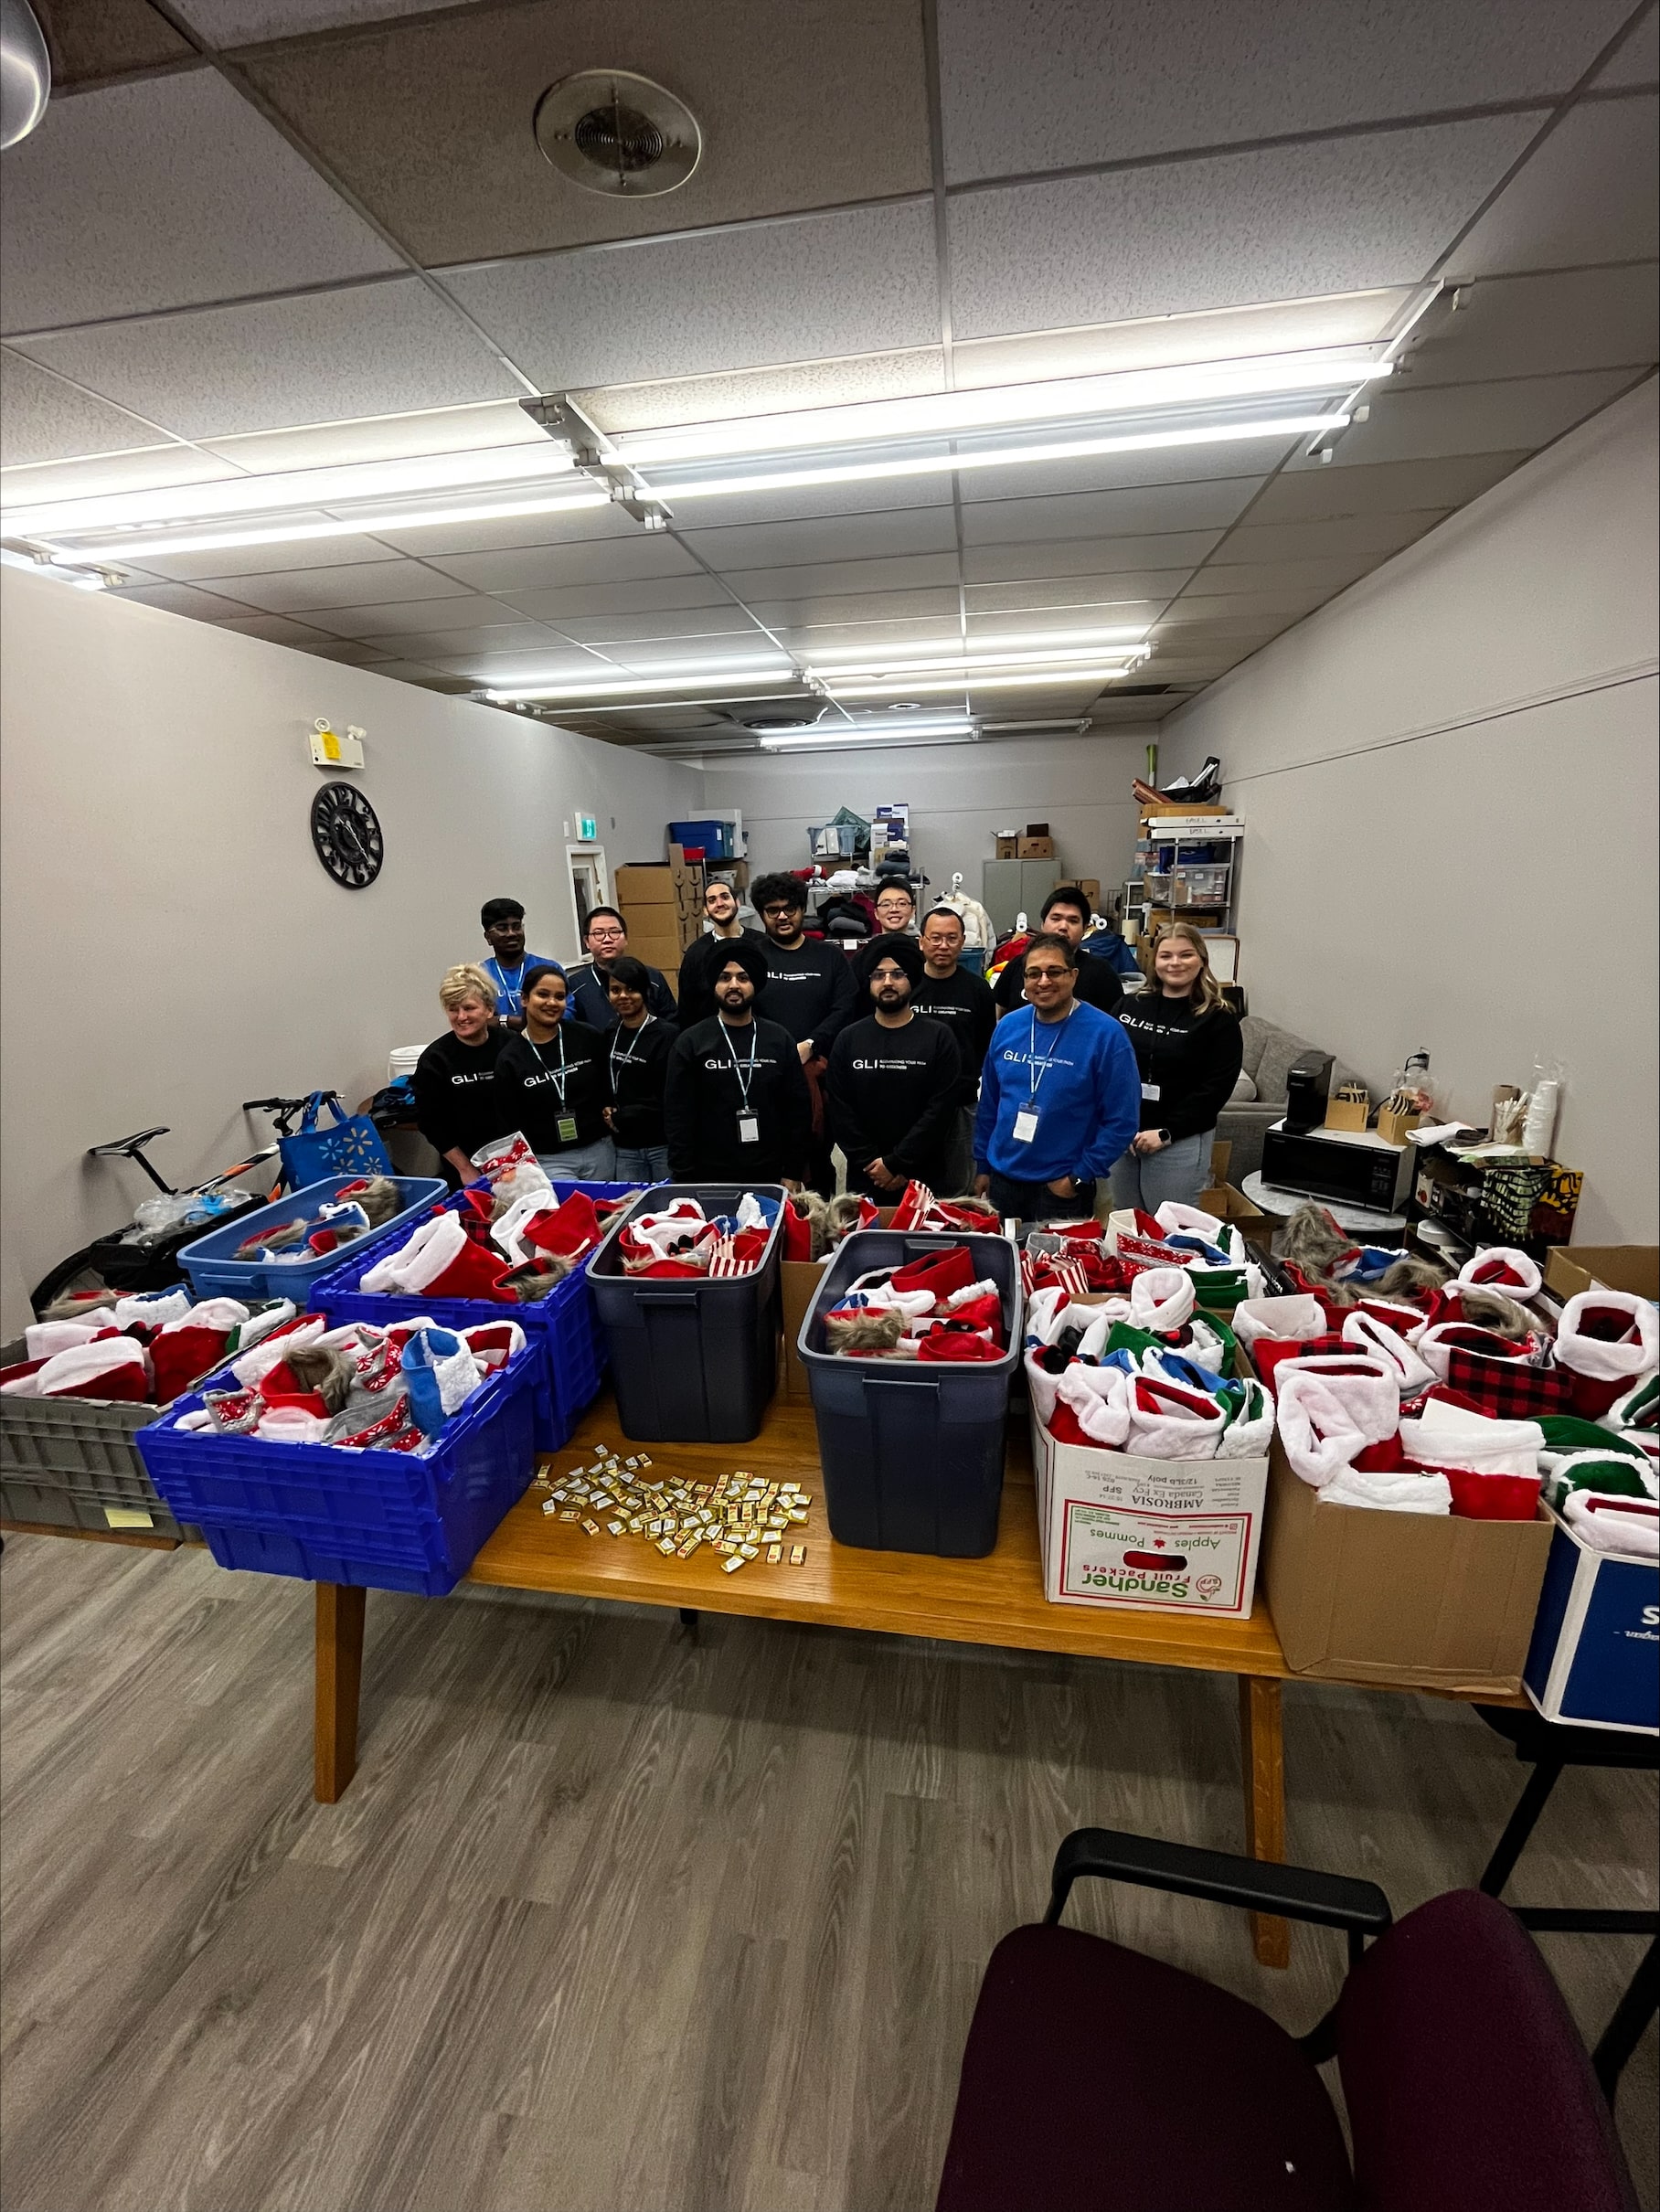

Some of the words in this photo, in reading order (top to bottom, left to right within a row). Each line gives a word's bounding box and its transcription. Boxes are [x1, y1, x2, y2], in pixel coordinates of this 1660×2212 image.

[1119, 1014, 1144, 1028] GLI
[1003, 1049, 1027, 1063] GLI
[705, 1058, 731, 1069] GLI
[852, 1059, 878, 1069] GLI
[452, 1073, 478, 1085] GLI
[524, 1071, 549, 1087] GLI
[1148, 1474, 1167, 1484] poly
[1102, 1485, 1123, 1494] SFP
[1168, 1491, 1203, 1499] Canada
[1132, 1494, 1204, 1509] AMBROSIA
[1090, 1528, 1145, 1547] Pommes
[1175, 1537, 1220, 1551] Apples
[1082, 1564, 1146, 1579] Packers
[1154, 1571, 1191, 1583] Fruit
[1081, 1573, 1188, 1599] Sandher
